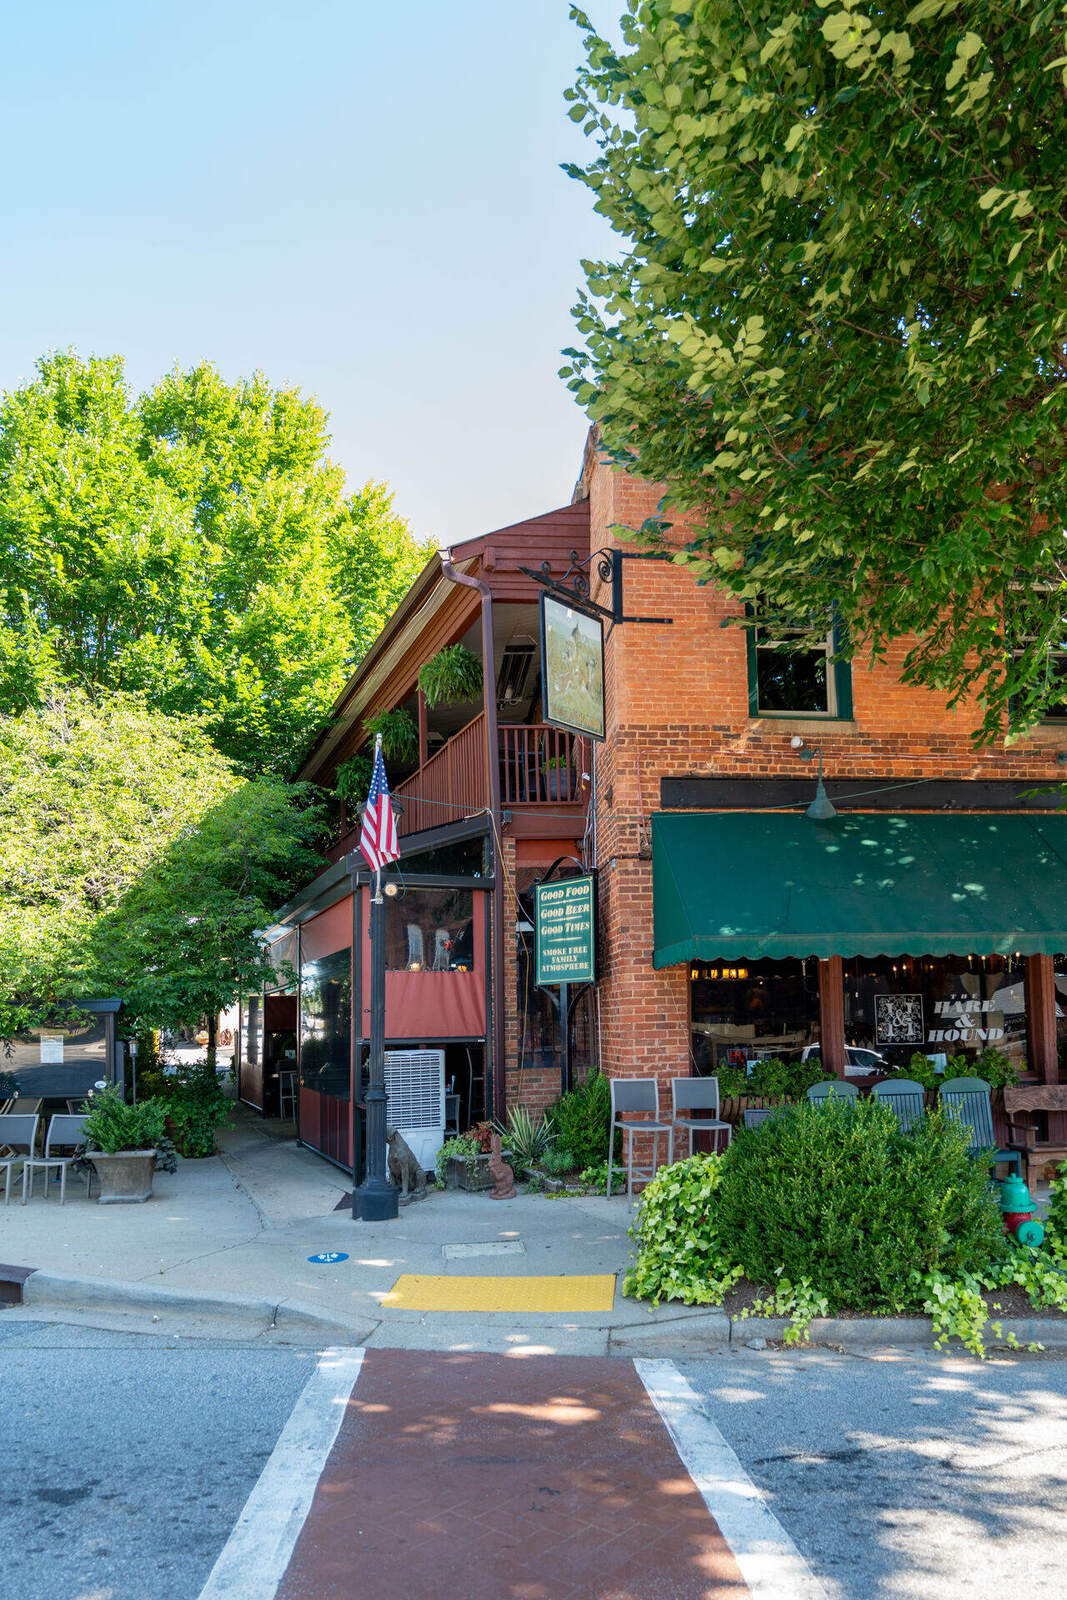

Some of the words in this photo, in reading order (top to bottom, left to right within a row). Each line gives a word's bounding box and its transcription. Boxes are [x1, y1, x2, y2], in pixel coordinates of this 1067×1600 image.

[541, 891, 564, 901] GOOD
[566, 885, 589, 897] FOOD
[541, 908, 564, 918] GOOD
[566, 904, 590, 915] BEER
[541, 926, 563, 935] GOOD
[565, 922, 590, 932] TIMES
[543, 948, 567, 956] SMOKE
[552, 955, 577, 963] FAMILY
[542, 962, 589, 972] ATMOSPHERE
[934, 1000, 996, 1013] HARE
[955, 1013, 976, 1028] &
[928, 1028, 1004, 1042] HOUND
